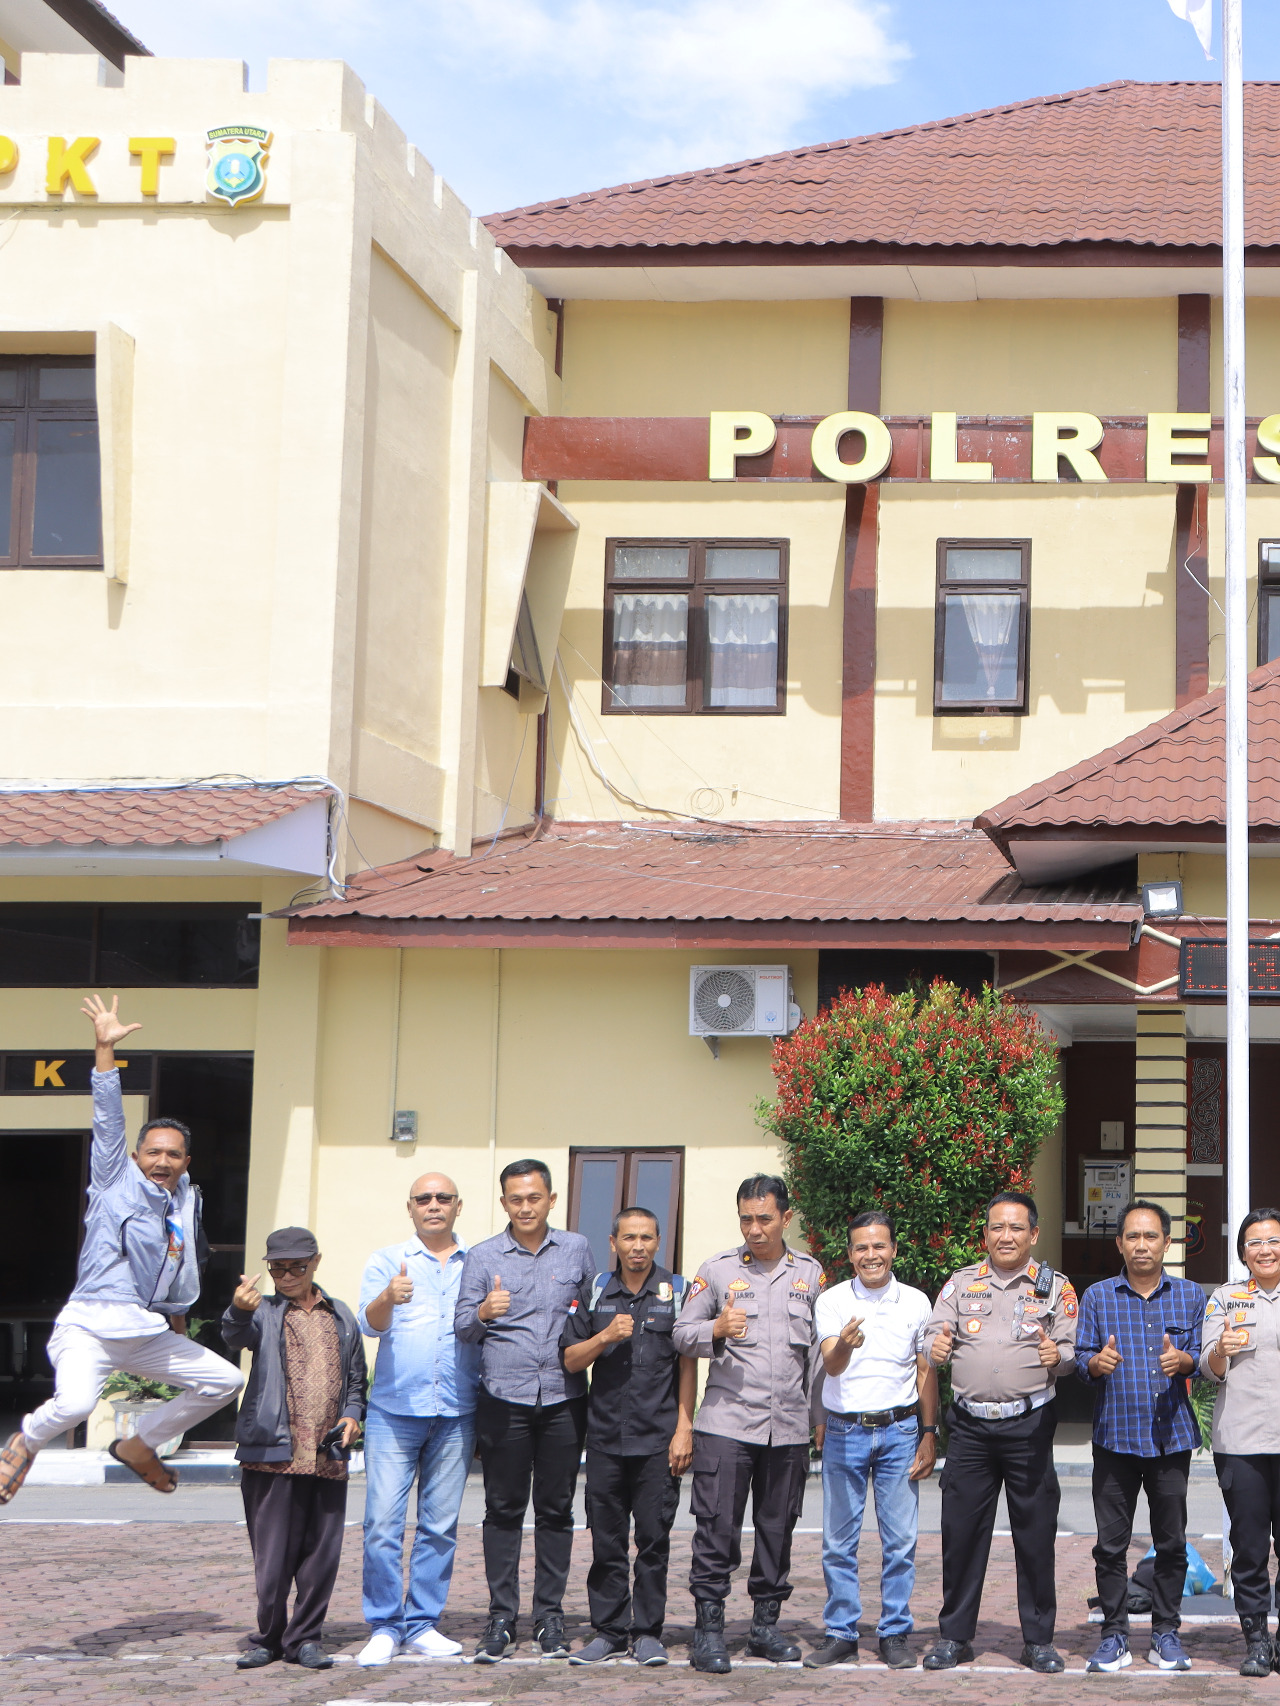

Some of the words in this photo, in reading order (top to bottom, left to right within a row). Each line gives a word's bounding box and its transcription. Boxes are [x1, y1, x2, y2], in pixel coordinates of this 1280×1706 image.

[208, 127, 243, 138] SUMATERA
[244, 127, 265, 138] UTARA
[724, 1292, 755, 1300] EUARD
[1227, 1301, 1256, 1310] RINTAR
